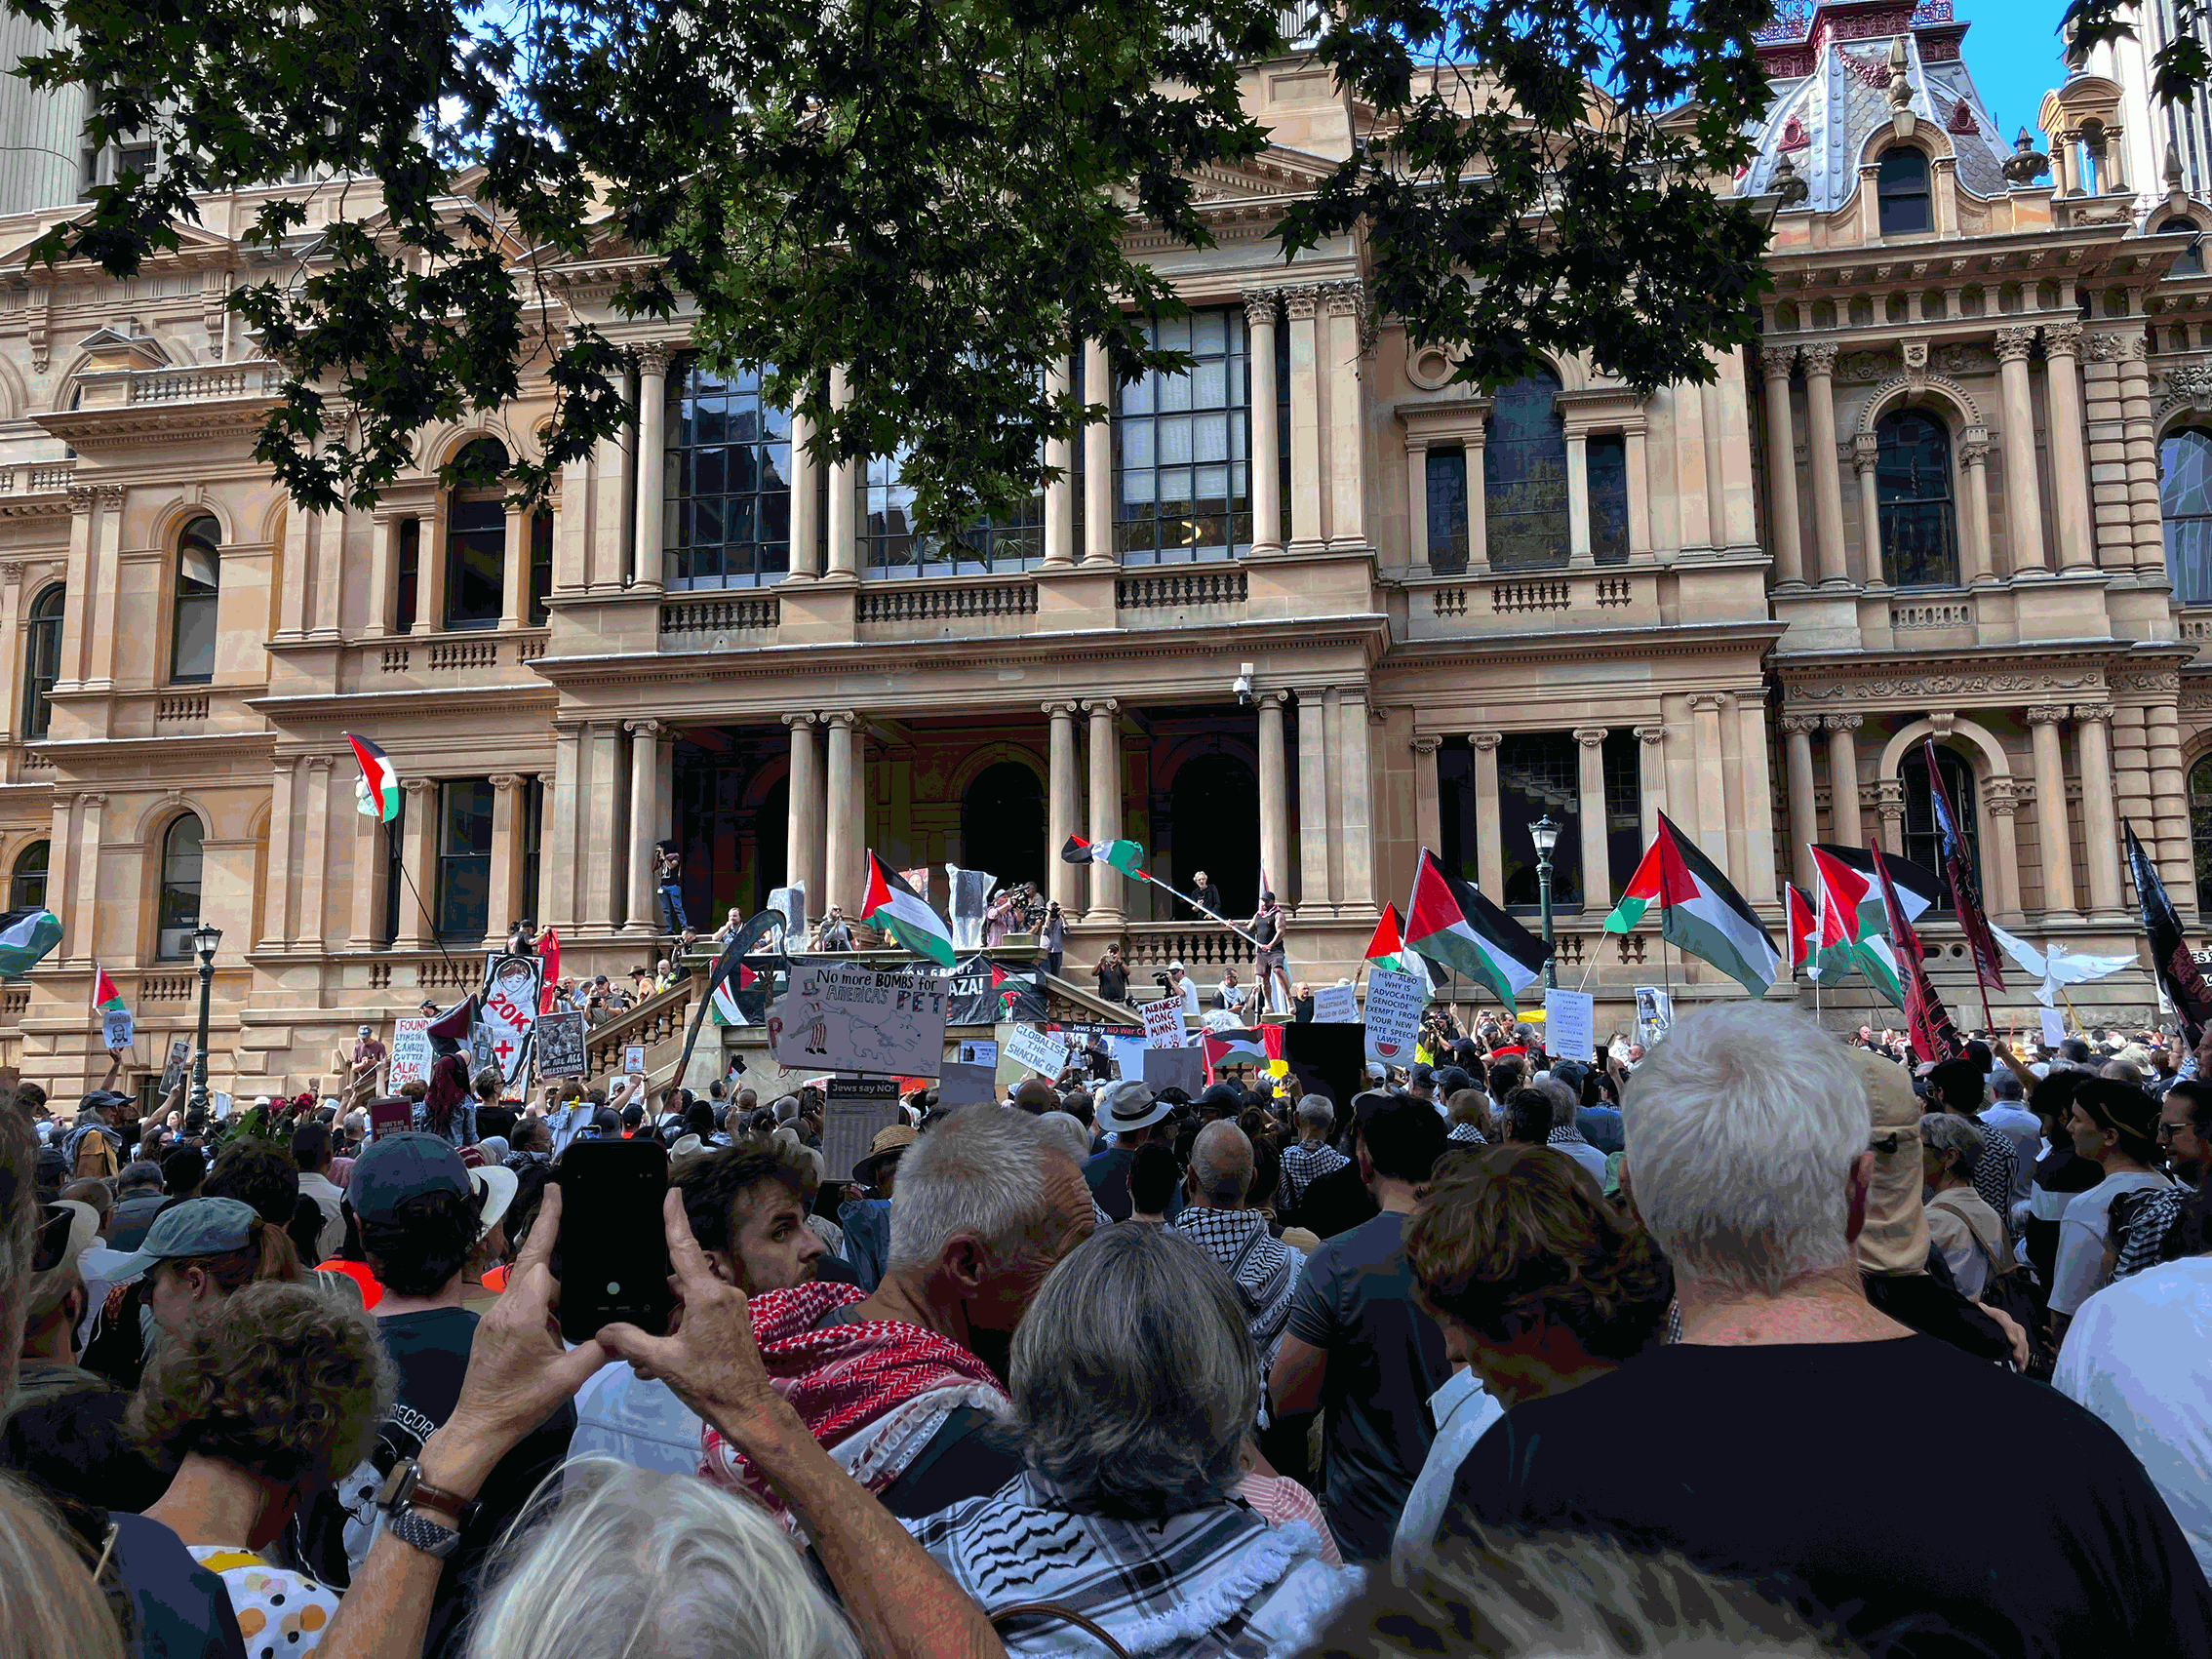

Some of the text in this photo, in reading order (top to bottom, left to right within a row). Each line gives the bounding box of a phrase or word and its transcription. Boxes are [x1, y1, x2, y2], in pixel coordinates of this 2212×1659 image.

[930, 964, 973, 977] GROUP
[816, 969, 938, 991] No more BOMBS for
[948, 977, 984, 996] AZA!
[1384, 981, 1402, 990] WHY
[1399, 975, 1419, 986] ALBO,
[826, 985, 889, 1005] AMERICA'S
[896, 990, 945, 1014] PET
[1371, 987, 1423, 1004] "ADVOCATING
[1145, 997, 1182, 1014] ALBANESE
[1371, 997, 1413, 1010] GENOCIDE"
[487, 993, 532, 1033] 20K
[1146, 1010, 1174, 1024] WONG
[1365, 1006, 1420, 1021] EXEMPT FROM
[1150, 1020, 1178, 1037] MINNS
[1371, 1015, 1412, 1029] YOUR NEW
[1367, 1025, 1417, 1040] HATE SPEECH
[1376, 1035, 1402, 1045] LAWS?
[1015, 1025, 1070, 1057] GLOBALISE
[1027, 1040, 1047, 1055] THE
[552, 1057, 565, 1066] ARE
[567, 1052, 582, 1063] ALL
[1007, 1044, 1046, 1067] SHAKING
[1045, 1062, 1060, 1076] OFF
[542, 1064, 583, 1076] PALESTINIANS
[832, 1084, 894, 1093] Jews say NO!
